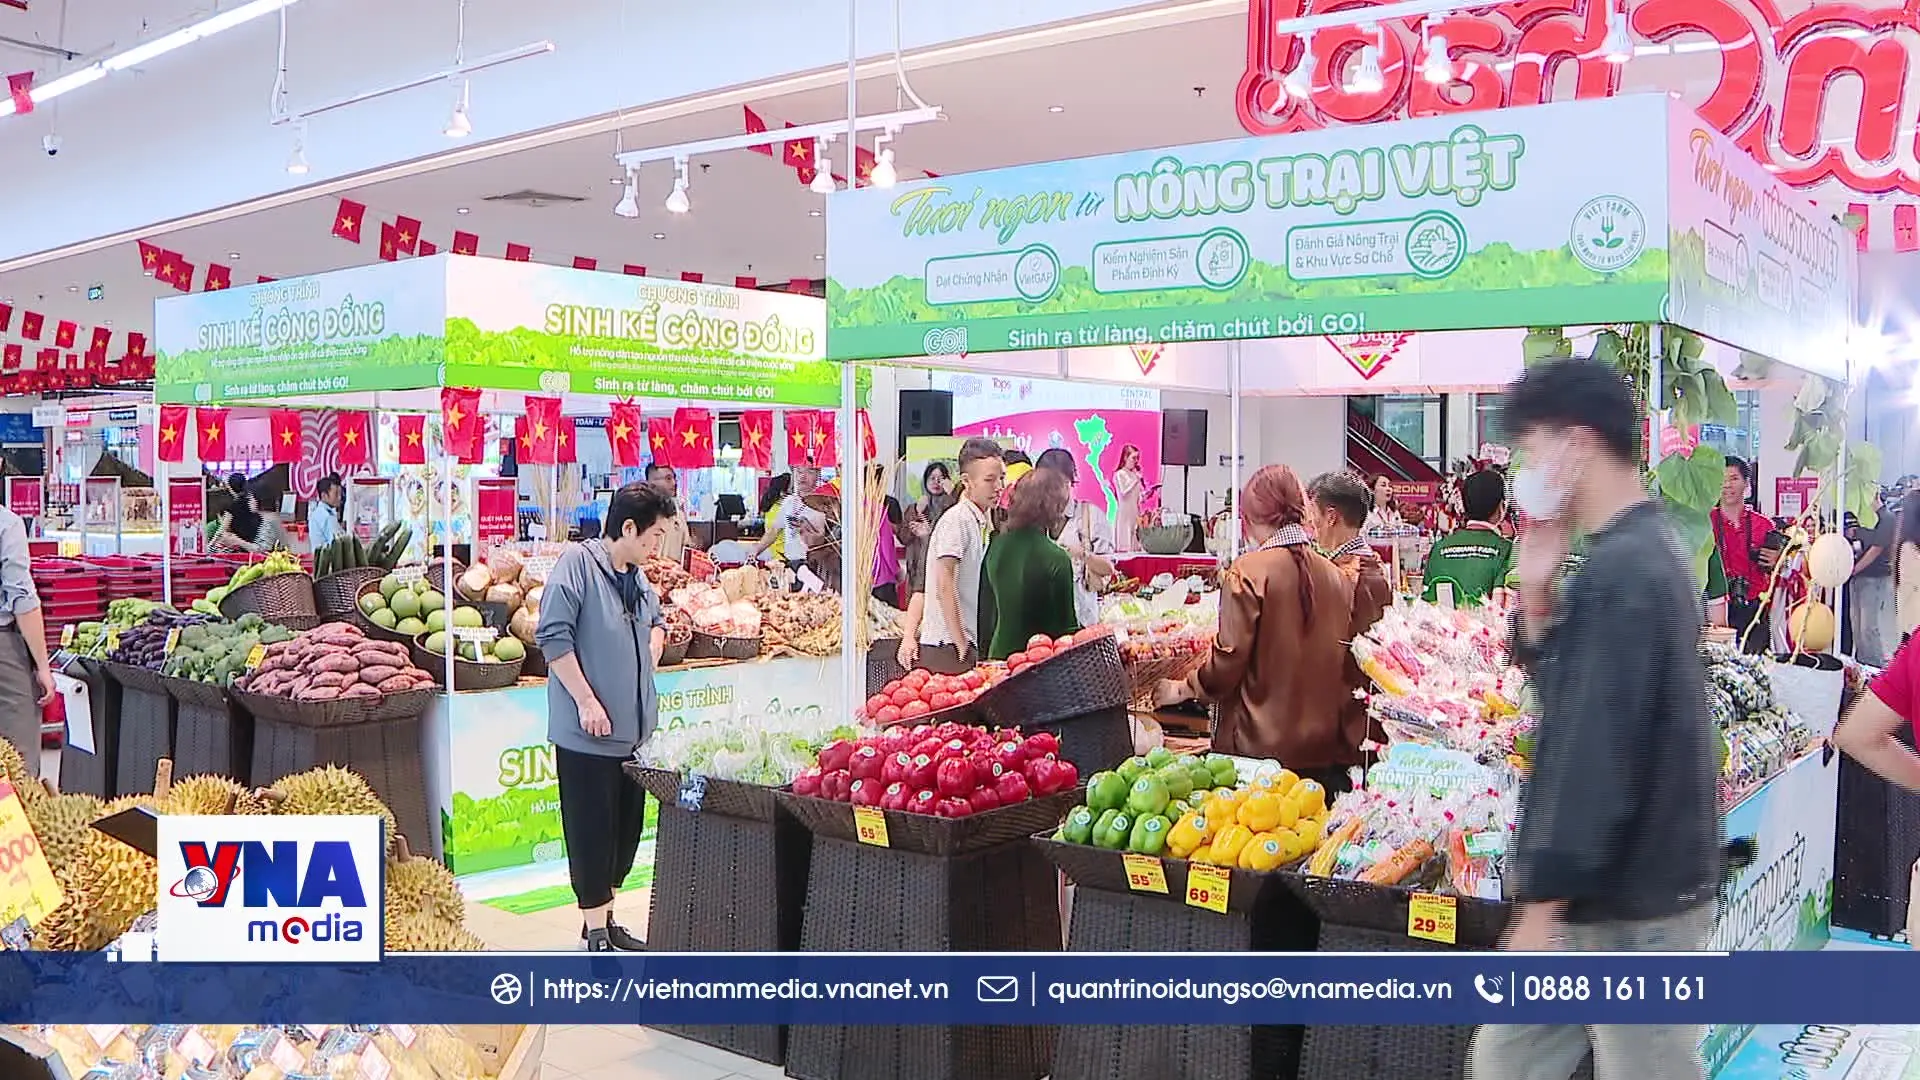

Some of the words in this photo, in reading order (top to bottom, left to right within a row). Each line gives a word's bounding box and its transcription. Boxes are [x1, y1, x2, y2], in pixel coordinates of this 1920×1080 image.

[890, 186, 983, 238] Tươi
[979, 191, 1074, 245] ngon
[1075, 191, 1105, 217] từ
[1114, 156, 1255, 223] NÔNG
[1257, 147, 1385, 215] TRẠI
[1388, 124, 1526, 207] VIỆT
[1295, 236, 1324, 250] Đánh
[1346, 233, 1376, 248] Nông
[1295, 258, 1304, 268] &
[1306, 256, 1328, 268] Khu
[198, 320, 236, 351] SINH
[240, 306, 263, 347] KẾ
[265, 306, 319, 348] CỘNG
[323, 292, 385, 339] ĐỒNG
[545, 303, 614, 338] SINH
[621, 304, 660, 342] KẾ
[662, 309, 737, 351] CỘNG
[744, 314, 814, 354] ĐỒNG
[1008, 329, 1048, 348] Sinh
[1055, 331, 1072, 346] ra
[1078, 326, 1099, 345] từ
[1104, 324, 1153, 346] làng,
[1160, 321, 1216, 340] chăm
[1222, 317, 1270, 337] chút
[1277, 315, 1312, 335] bởi
[1320, 312, 1365, 334] GO!
[924, 327, 967, 355] GO!
[594, 377, 619, 391] Sinh
[623, 380, 634, 391] ra
[711, 383, 734, 396] chút
[755, 386, 775, 398] GO!
[687, 684, 735, 708] TRÌNH
[498, 744, 559, 787] SIN
[1190, 888, 1209, 903] 69
[1413, 917, 1436, 932] 29
